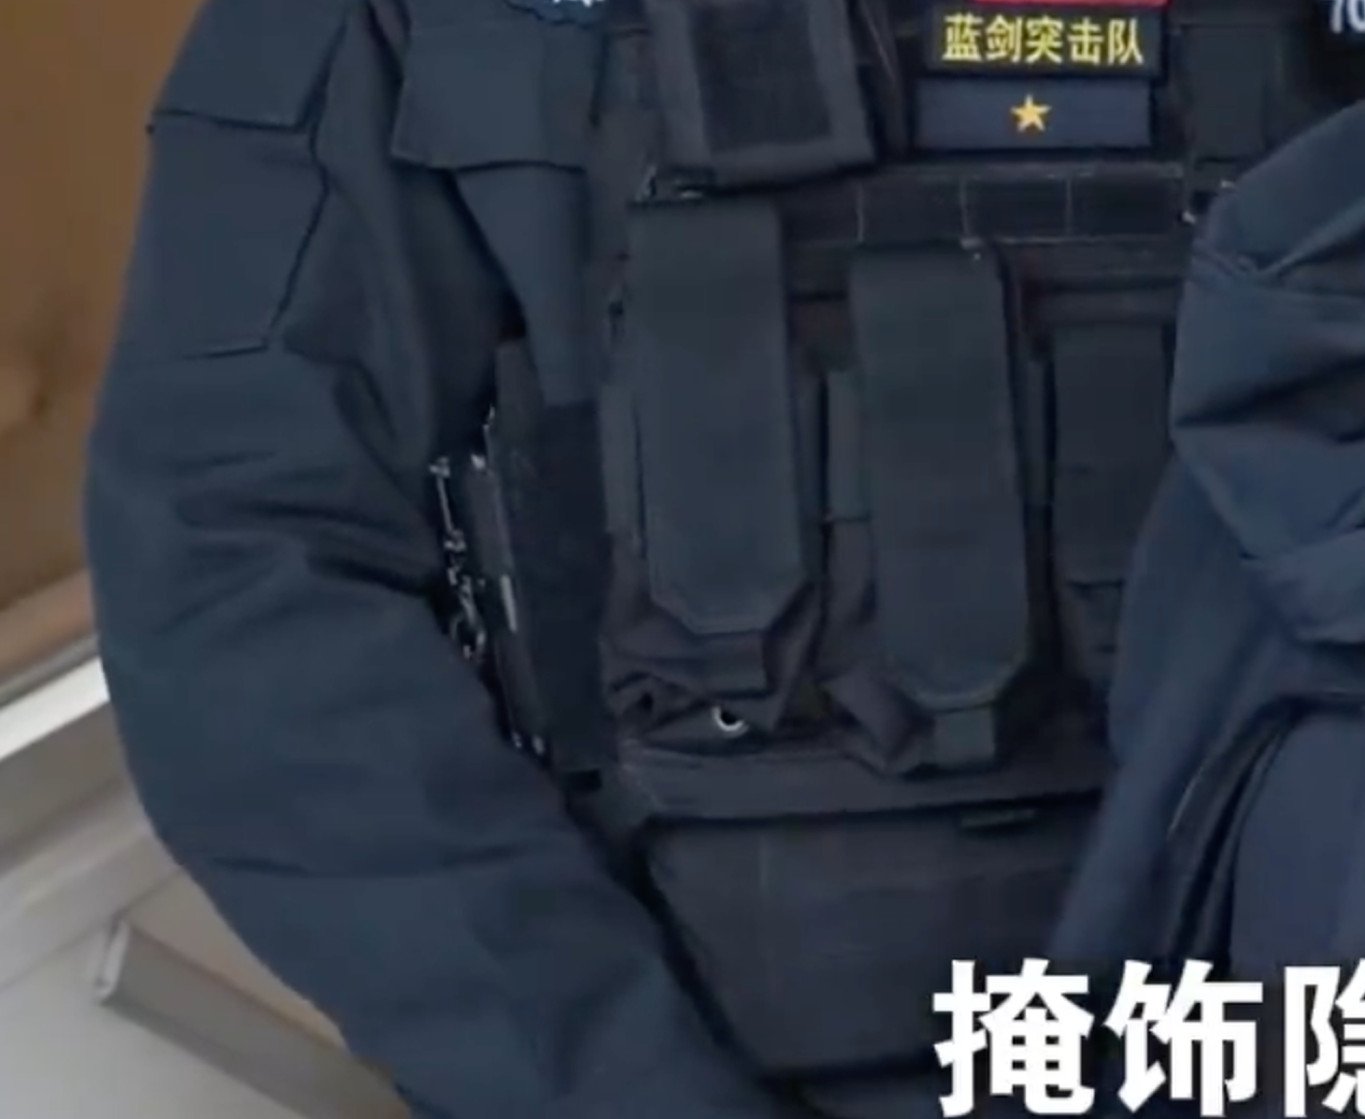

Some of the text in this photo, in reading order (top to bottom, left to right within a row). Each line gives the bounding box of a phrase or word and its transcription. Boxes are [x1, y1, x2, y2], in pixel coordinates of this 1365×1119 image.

[942, 12, 1144, 65] 蓝剑突击队
